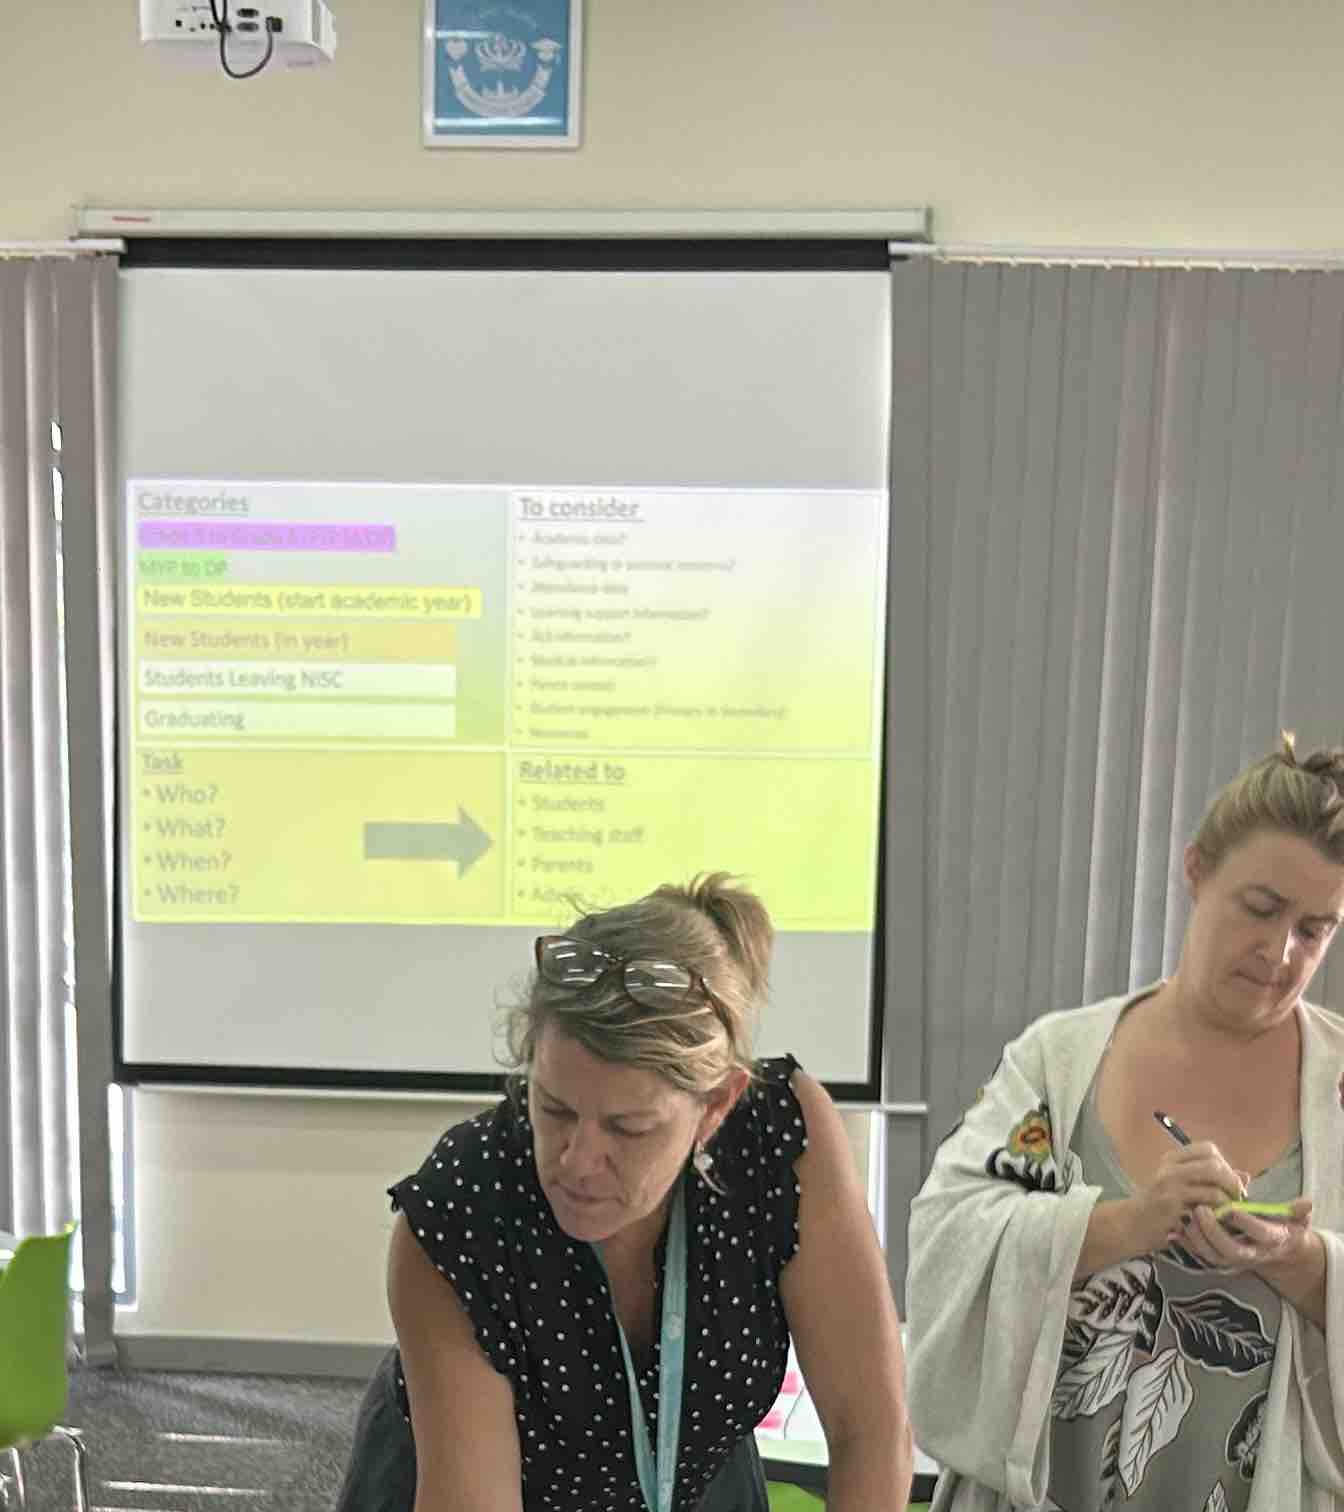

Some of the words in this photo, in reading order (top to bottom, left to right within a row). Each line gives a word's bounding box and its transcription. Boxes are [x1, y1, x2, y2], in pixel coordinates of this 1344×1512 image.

[138, 491, 250, 513] Categories
[519, 497, 544, 517] To
[549, 497, 640, 517] consider
[144, 590, 185, 607] New
[191, 588, 272, 609] Students
[277, 590, 326, 612] (start
[331, 591, 419, 610] academic
[423, 592, 473, 614] year)
[144, 631, 185, 648] New
[191, 630, 269, 650] Students
[304, 633, 353, 654] year)
[144, 668, 224, 688] Students
[229, 669, 297, 691] Leaving
[301, 670, 344, 689] NISC
[144, 707, 247, 730] Graduating
[142, 751, 184, 770] Task
[519, 760, 598, 780] Related
[604, 762, 626, 780] to
[157, 783, 219, 804] Who?
[532, 795, 606, 812] Students
[157, 816, 226, 838] What?
[532, 825, 603, 846] Teaching
[157, 850, 233, 871] When?
[532, 856, 594, 873] Parents
[157, 883, 240, 904] Where?
